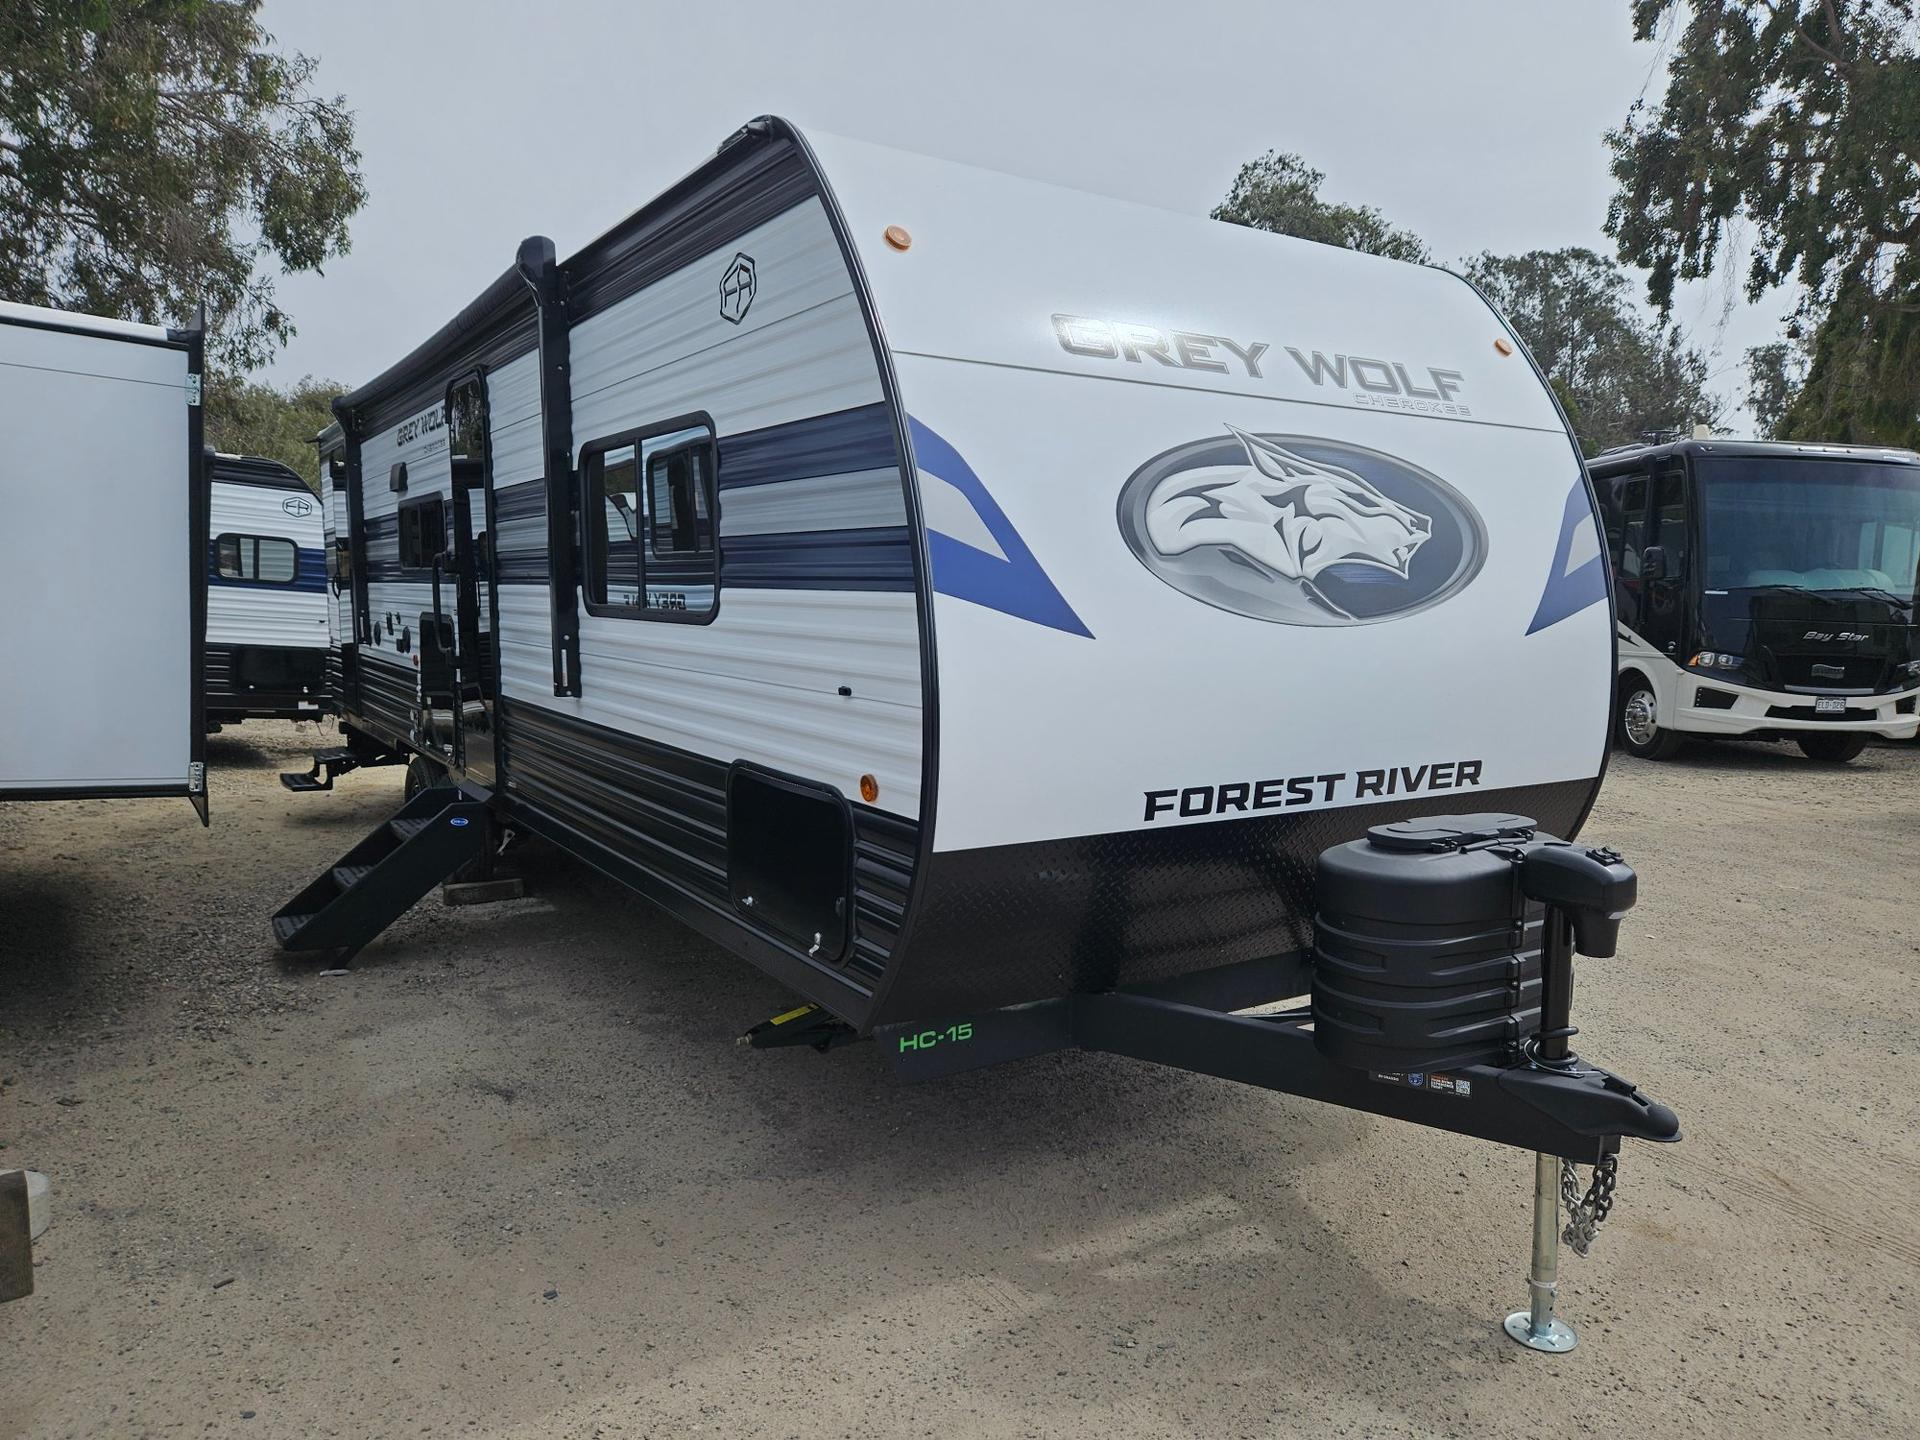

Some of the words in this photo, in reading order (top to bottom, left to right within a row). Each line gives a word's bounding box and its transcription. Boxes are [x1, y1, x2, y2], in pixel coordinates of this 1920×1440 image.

[1051, 313, 1270, 379] GREY
[1284, 346, 1465, 402] WOLF
[1353, 392, 1472, 417] CHEROKEE
[397, 418, 420, 447] GREY
[1802, 631, 1834, 642] Bay
[1836, 632, 1869, 641] Star
[1144, 773, 1346, 822] FOREST
[1355, 759, 1483, 799] RIVER
[899, 1022, 973, 1053] HC-15
